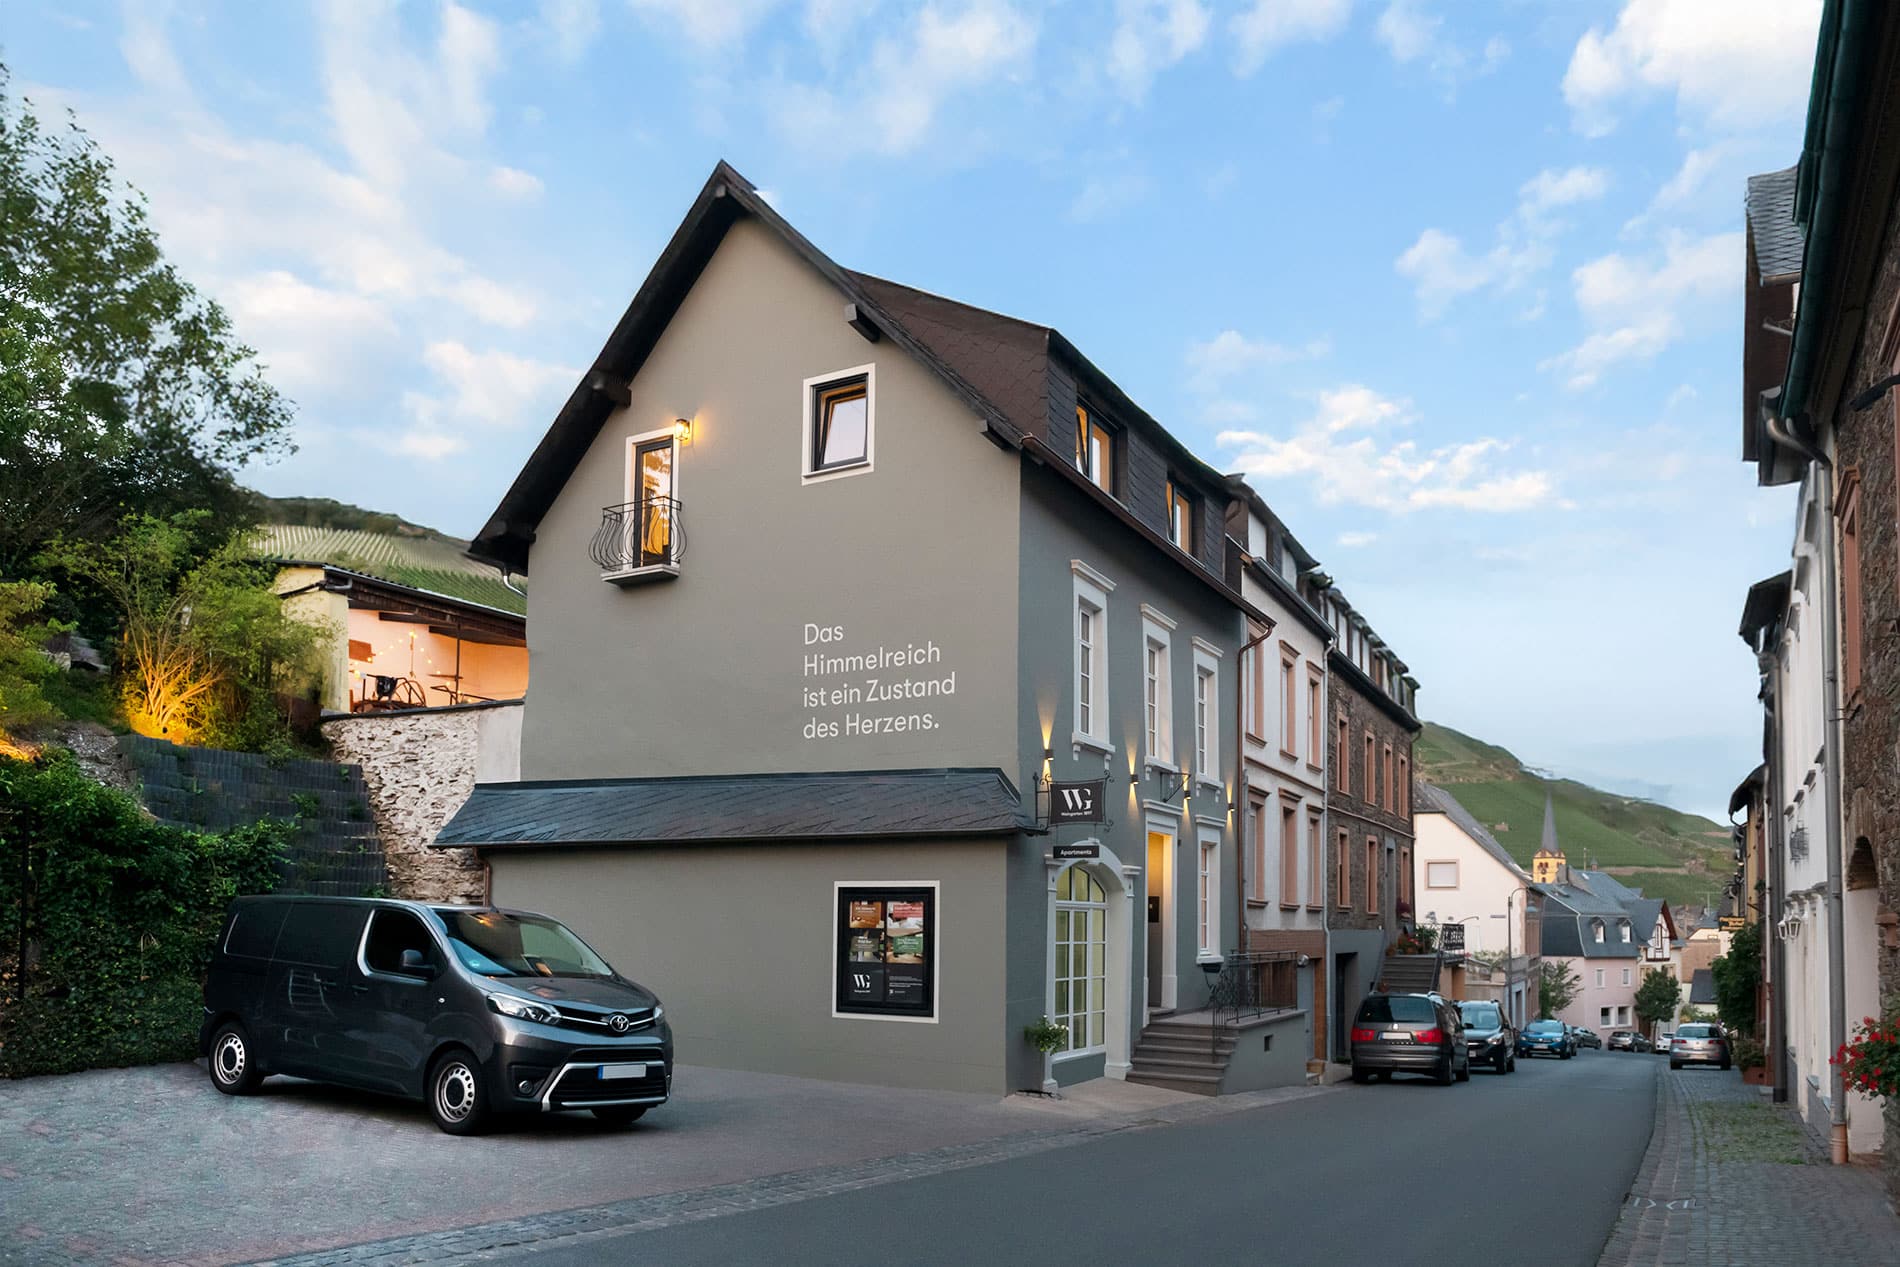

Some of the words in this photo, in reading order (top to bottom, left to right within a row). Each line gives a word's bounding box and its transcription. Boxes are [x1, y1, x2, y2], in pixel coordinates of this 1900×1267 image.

[804, 623, 844, 645] Das
[804, 640, 940, 677] Himmelreich
[803, 687, 827, 708] ist
[831, 683, 861, 705] ein
[866, 671, 955, 702] Zustand
[803, 717, 839, 739] des
[846, 713, 940, 736] Herzens.
[1061, 788, 1092, 810] WG
